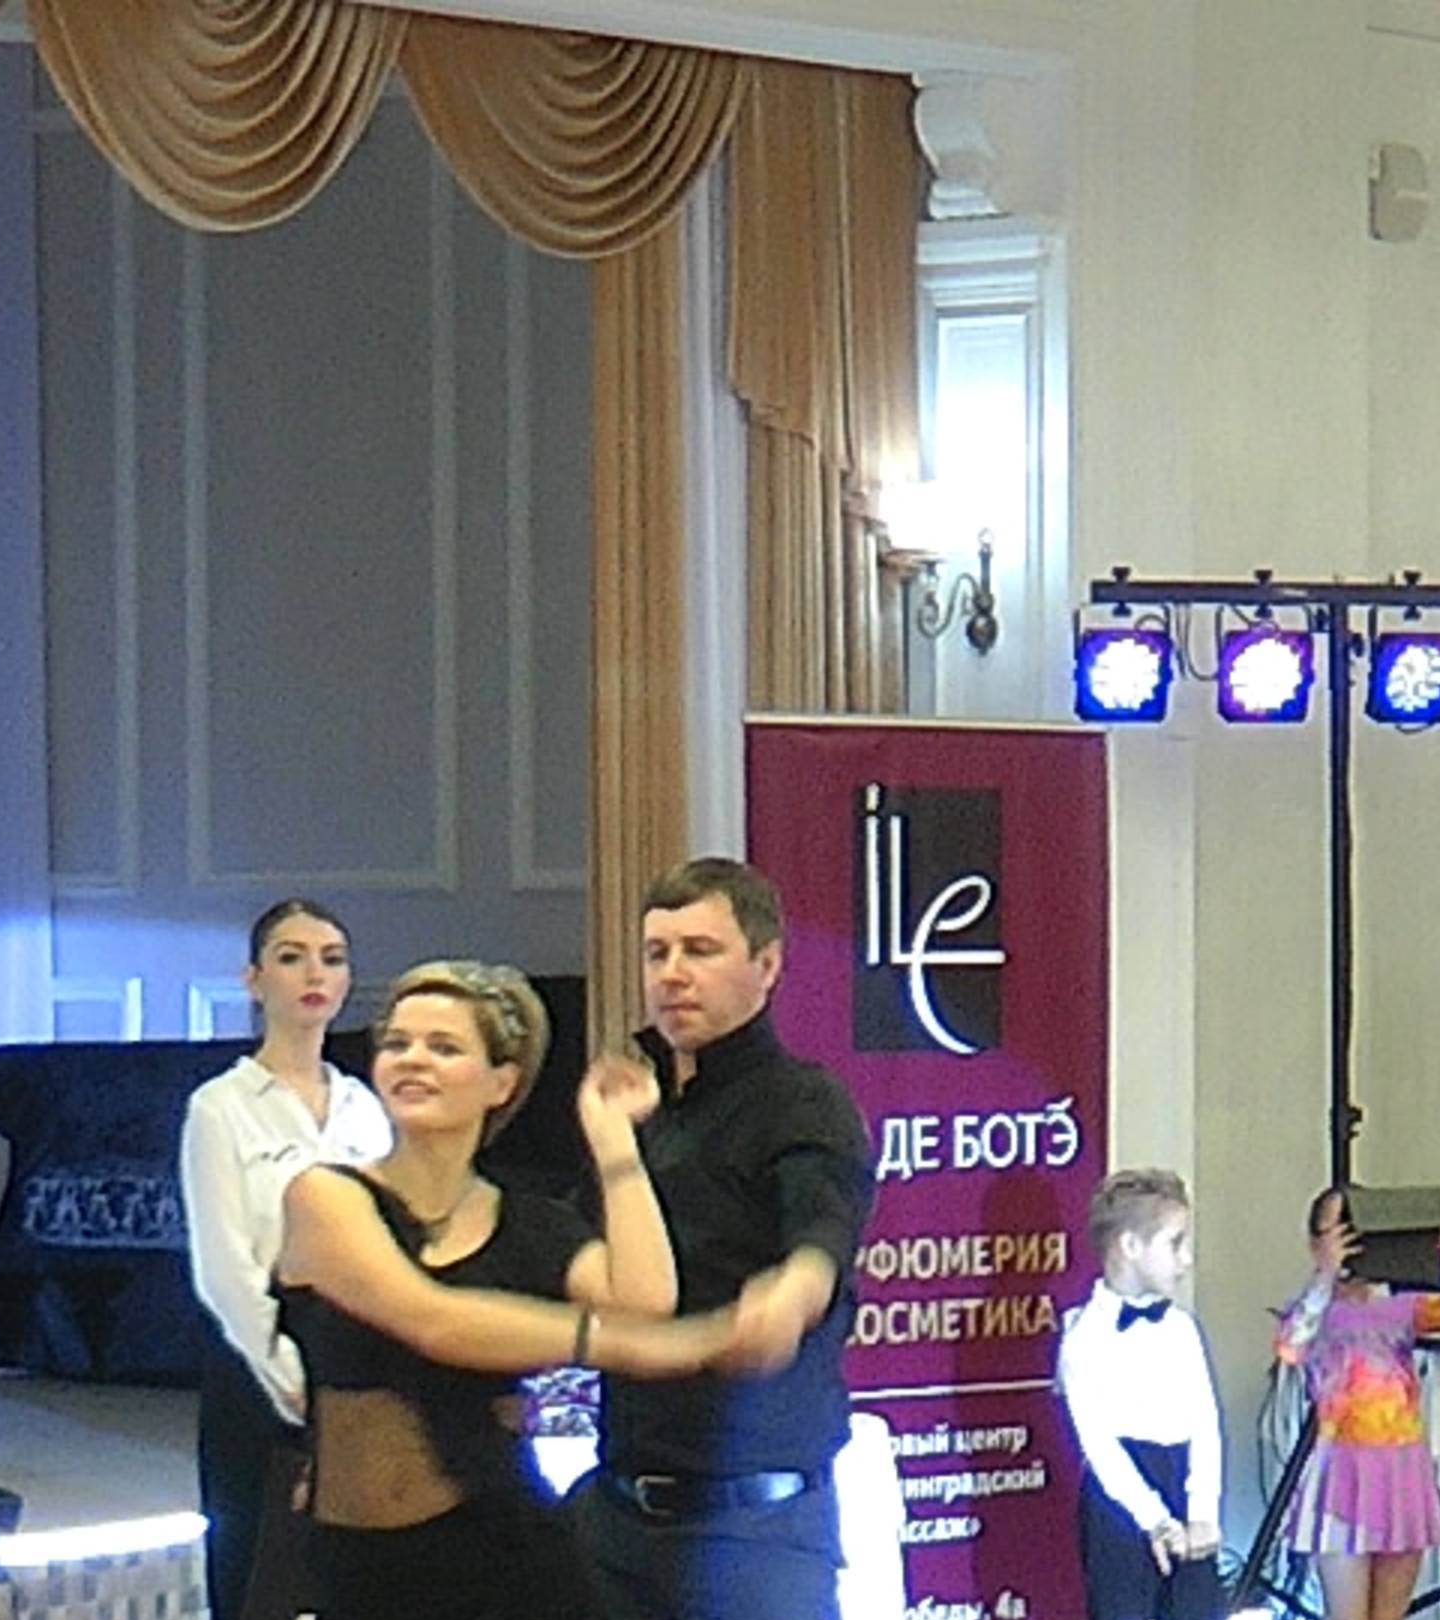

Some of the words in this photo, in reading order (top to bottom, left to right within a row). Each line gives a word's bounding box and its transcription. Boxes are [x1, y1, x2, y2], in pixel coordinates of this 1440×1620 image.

[876, 1116, 941, 1181] ДЕ
[854, 1232, 1068, 1281] ФЮМЕРИЯ
[846, 1295, 1057, 1346] ОСМЕТИКА
[954, 1425, 1028, 1455] центр
[899, 1459, 1046, 1505] инградский
